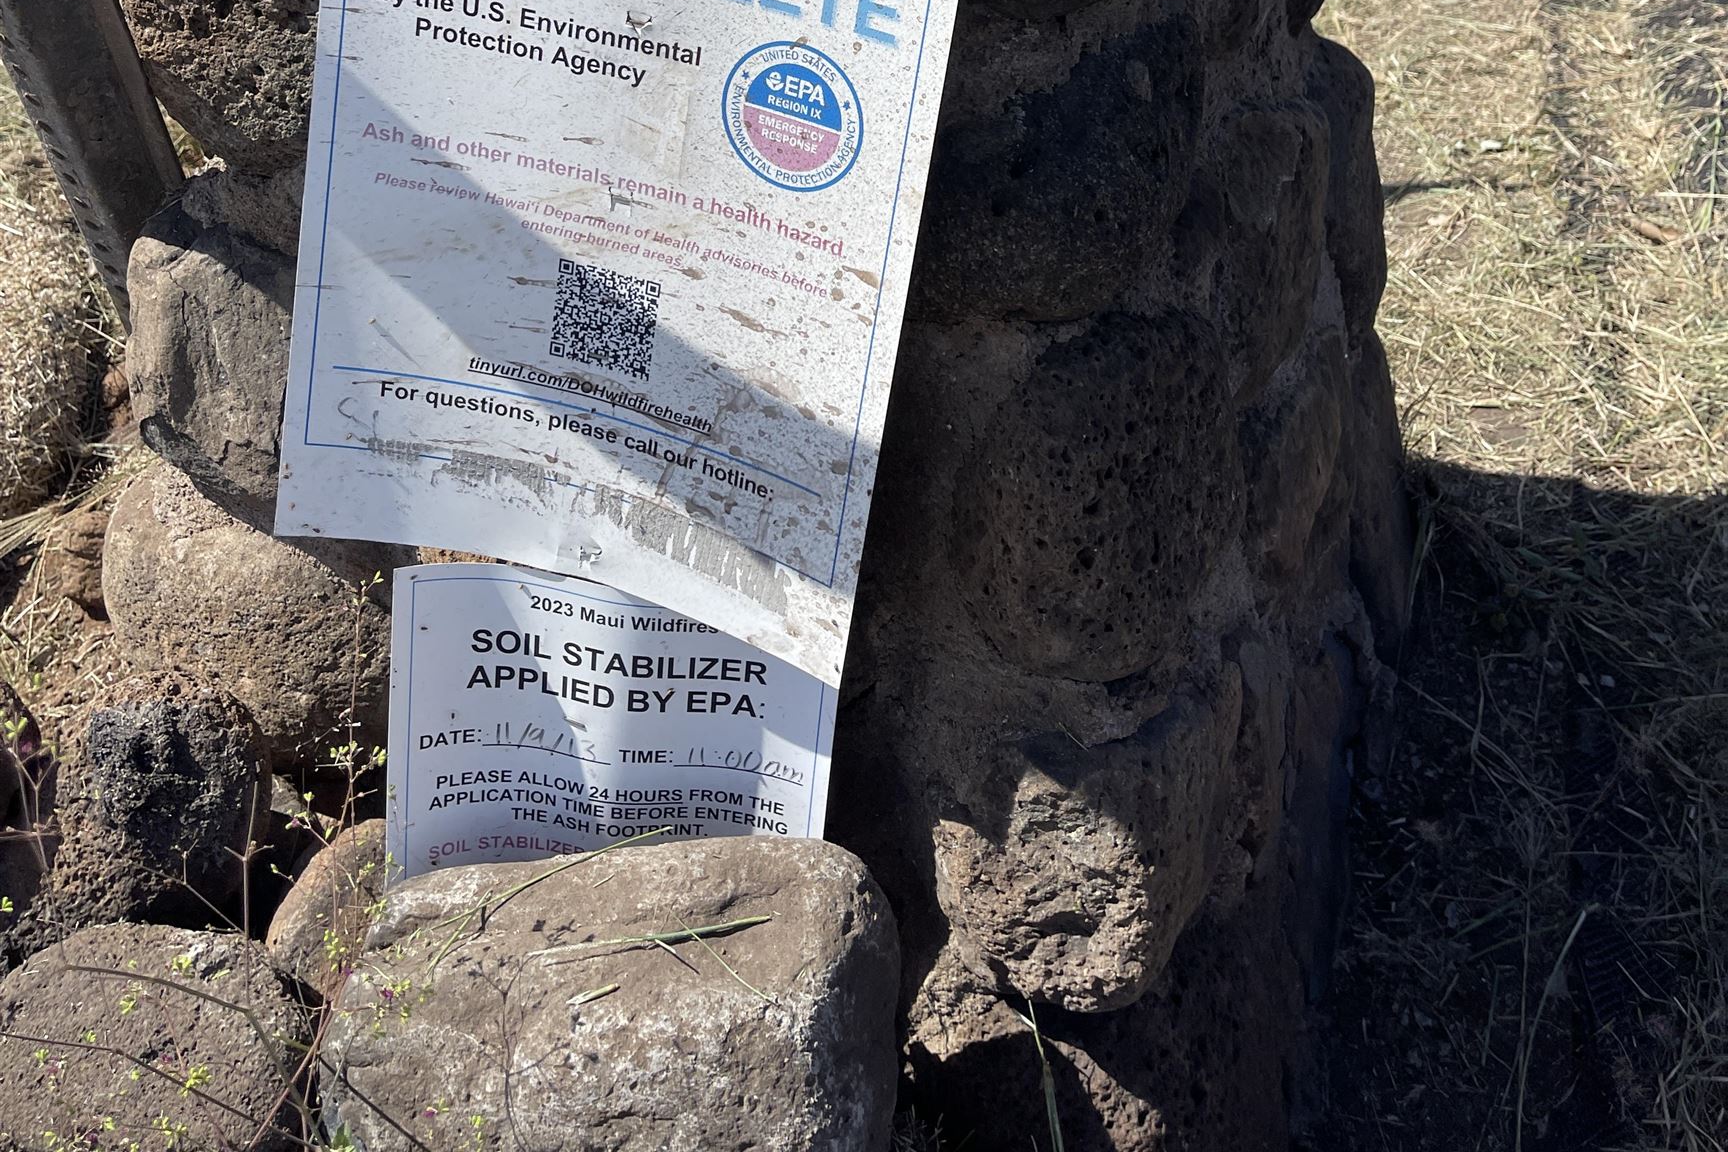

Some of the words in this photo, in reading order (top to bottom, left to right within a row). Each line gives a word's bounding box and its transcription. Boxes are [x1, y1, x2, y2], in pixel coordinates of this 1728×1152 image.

[415, 17, 544, 61] Protection
[551, 46, 647, 88] Agency
[520, 7, 702, 66] Environmental
[761, 50, 799, 63] UNITED
[801, 53, 837, 82] STATES
[767, 95, 809, 115] REGION
[810, 104, 822, 120] IX
[784, 75, 825, 106] EPA
[731, 84, 772, 176] ENVIRONMENTAL
[775, 163, 840, 185] PROTECTION
[838, 119, 856, 166] AGENCY
[362, 122, 404, 143] Ash
[411, 133, 451, 152] and
[456, 141, 512, 163] other
[516, 152, 611, 185] materials
[618, 176, 686, 205] remain
[693, 196, 704, 210] a
[709, 197, 771, 232] health
[776, 220, 847, 259] hazard.
[374, 172, 426, 191] Please
[430, 182, 481, 200] review
[543, 204, 631, 235] Department
[634, 228, 651, 241] of
[653, 230, 700, 255] Health
[703, 248, 778, 280] advisories
[781, 272, 828, 298] before
[521, 219, 582, 244] entering
[586, 232, 640, 255] burned
[469, 357, 712, 434] tinyurl.com/DOHwildfirehealth
[380, 380, 419, 401] For
[425, 390, 540, 427] questions,
[548, 414, 617, 444] please
[624, 435, 658, 458] call
[663, 450, 698, 470] our
[702, 458, 774, 501] hotline:
[530, 595, 574, 617] 2023
[580, 606, 625, 629] Maui
[631, 616, 718, 633] Wildfires
[471, 629, 551, 660] SOIL
[562, 642, 767, 685] STABILIZER
[466, 665, 615, 708] APPLIED
[627, 689, 676, 713] BY
[687, 691, 766, 719] EPA:
[419, 728, 482, 750] DATE:
[619, 749, 674, 764] TIME:
[428, 788, 557, 811] APPLICATION
[562, 797, 605, 818] TIME
[610, 806, 688, 820] BEFORE
[695, 808, 788, 835] ENTERING
[436, 770, 512, 789] PLEASE
[518, 771, 584, 795] ALLOW
[589, 786, 610, 800] 24
[615, 789, 683, 802] HOURS
[689, 789, 743, 806] FROM
[749, 796, 785, 816] THE
[511, 807, 548, 823] THE
[553, 814, 589, 833] ASH
[429, 836, 471, 859] SOIL
